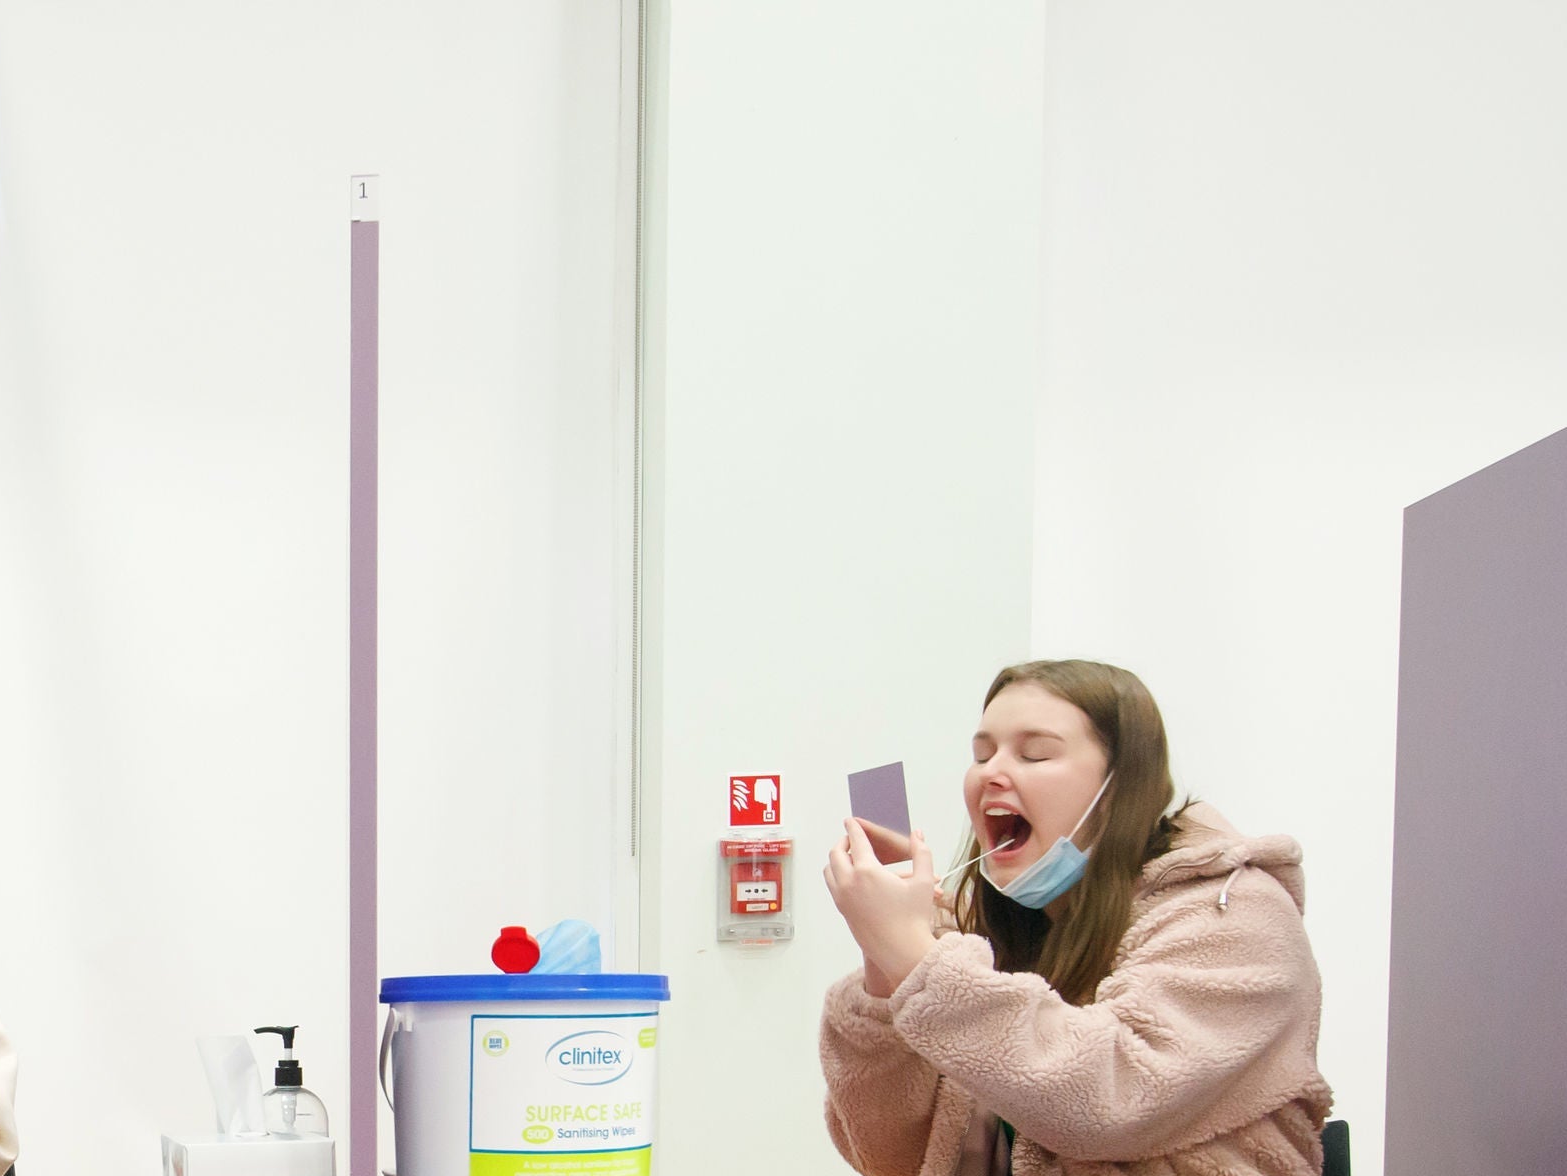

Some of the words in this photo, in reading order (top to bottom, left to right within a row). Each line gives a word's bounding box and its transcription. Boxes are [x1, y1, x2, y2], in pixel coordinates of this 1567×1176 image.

[358, 182, 368, 199] 1
[559, 1047, 622, 1066] clinitex
[526, 1104, 608, 1122] SURFACE
[614, 1102, 641, 1120] SAFE
[557, 1127, 609, 1140] Sanitising
